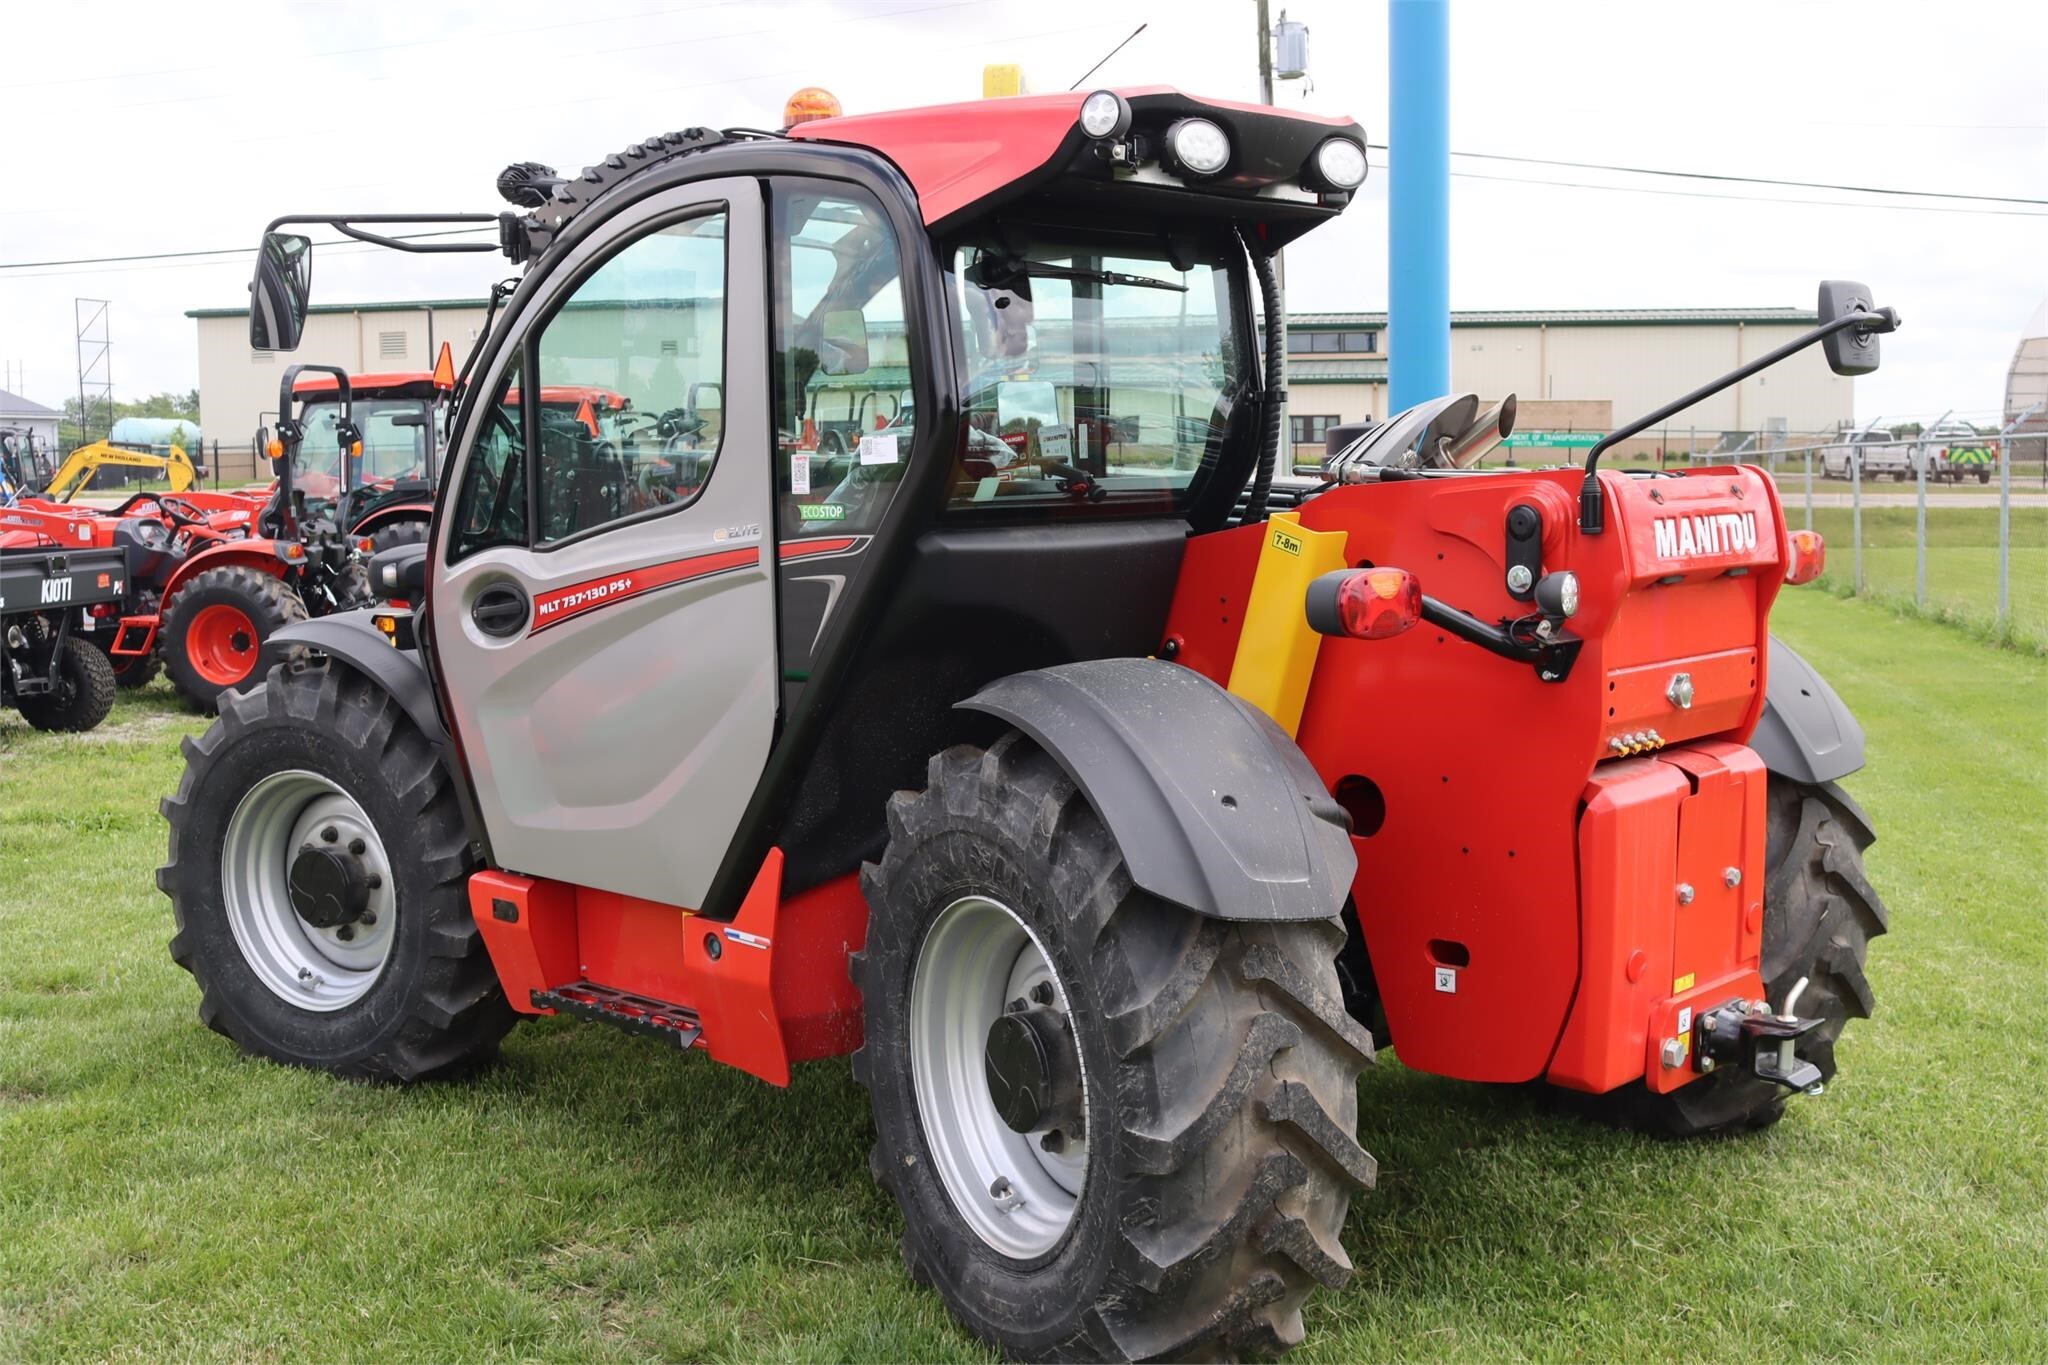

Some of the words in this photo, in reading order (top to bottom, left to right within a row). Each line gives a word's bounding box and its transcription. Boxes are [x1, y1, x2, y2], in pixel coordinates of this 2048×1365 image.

[1531, 433, 1541, 441] OF
[1543, 433, 1600, 441] TRANSPORTATION
[114, 454, 142, 463] HOLLAND
[802, 505, 843, 518] ECOSTOP
[728, 524, 760, 539] ELITE
[1654, 511, 1757, 558] MANITOU
[41, 577, 72, 603] KIOTI
[539, 599, 561, 615] MLT
[562, 586, 607, 608] 737-130
[609, 578, 632, 594] PS+
